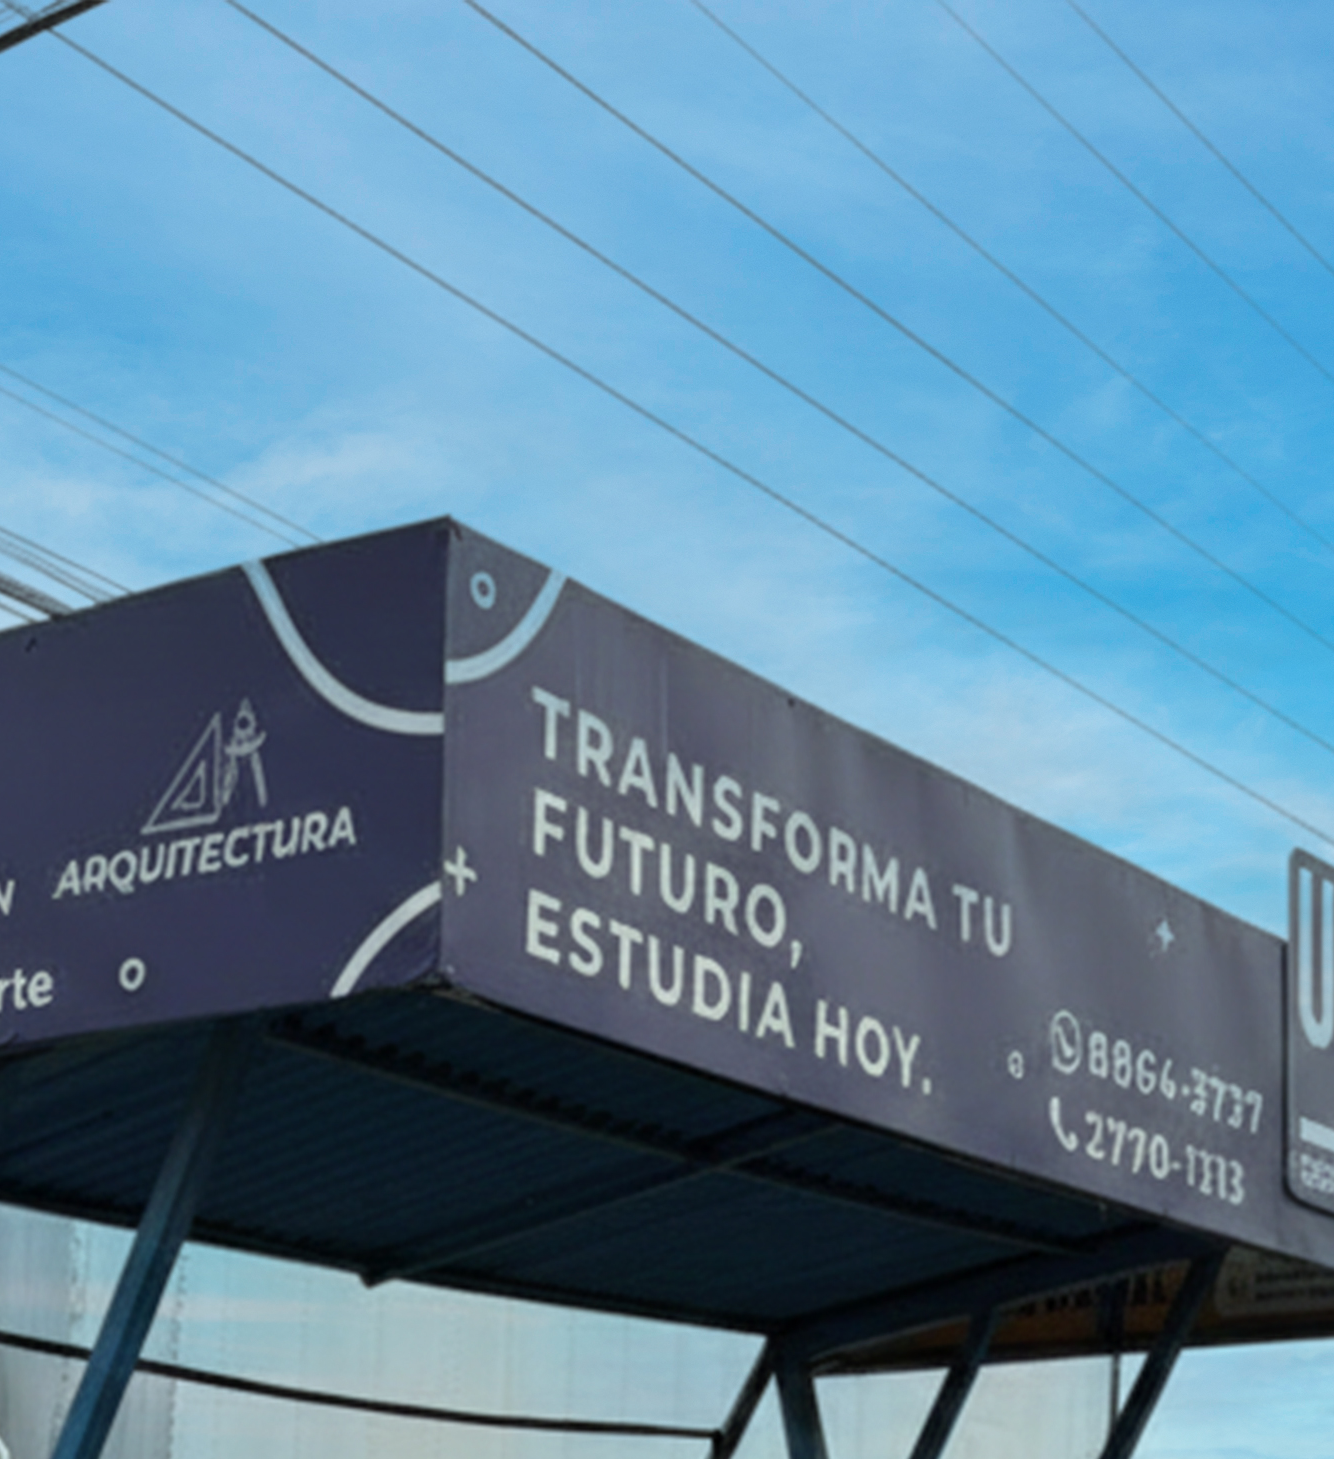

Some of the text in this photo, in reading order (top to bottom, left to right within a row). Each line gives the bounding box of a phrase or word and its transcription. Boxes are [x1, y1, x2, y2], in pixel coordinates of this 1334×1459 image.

[52, 806, 356, 899] ARQUITECTURA
[531, 686, 1013, 957] TRANSFORMA TU
[533, 788, 803, 969] FUTURO,
[525, 888, 932, 1095] ESTUDIA HOY.
[1298, 866, 1334, 1049] U
